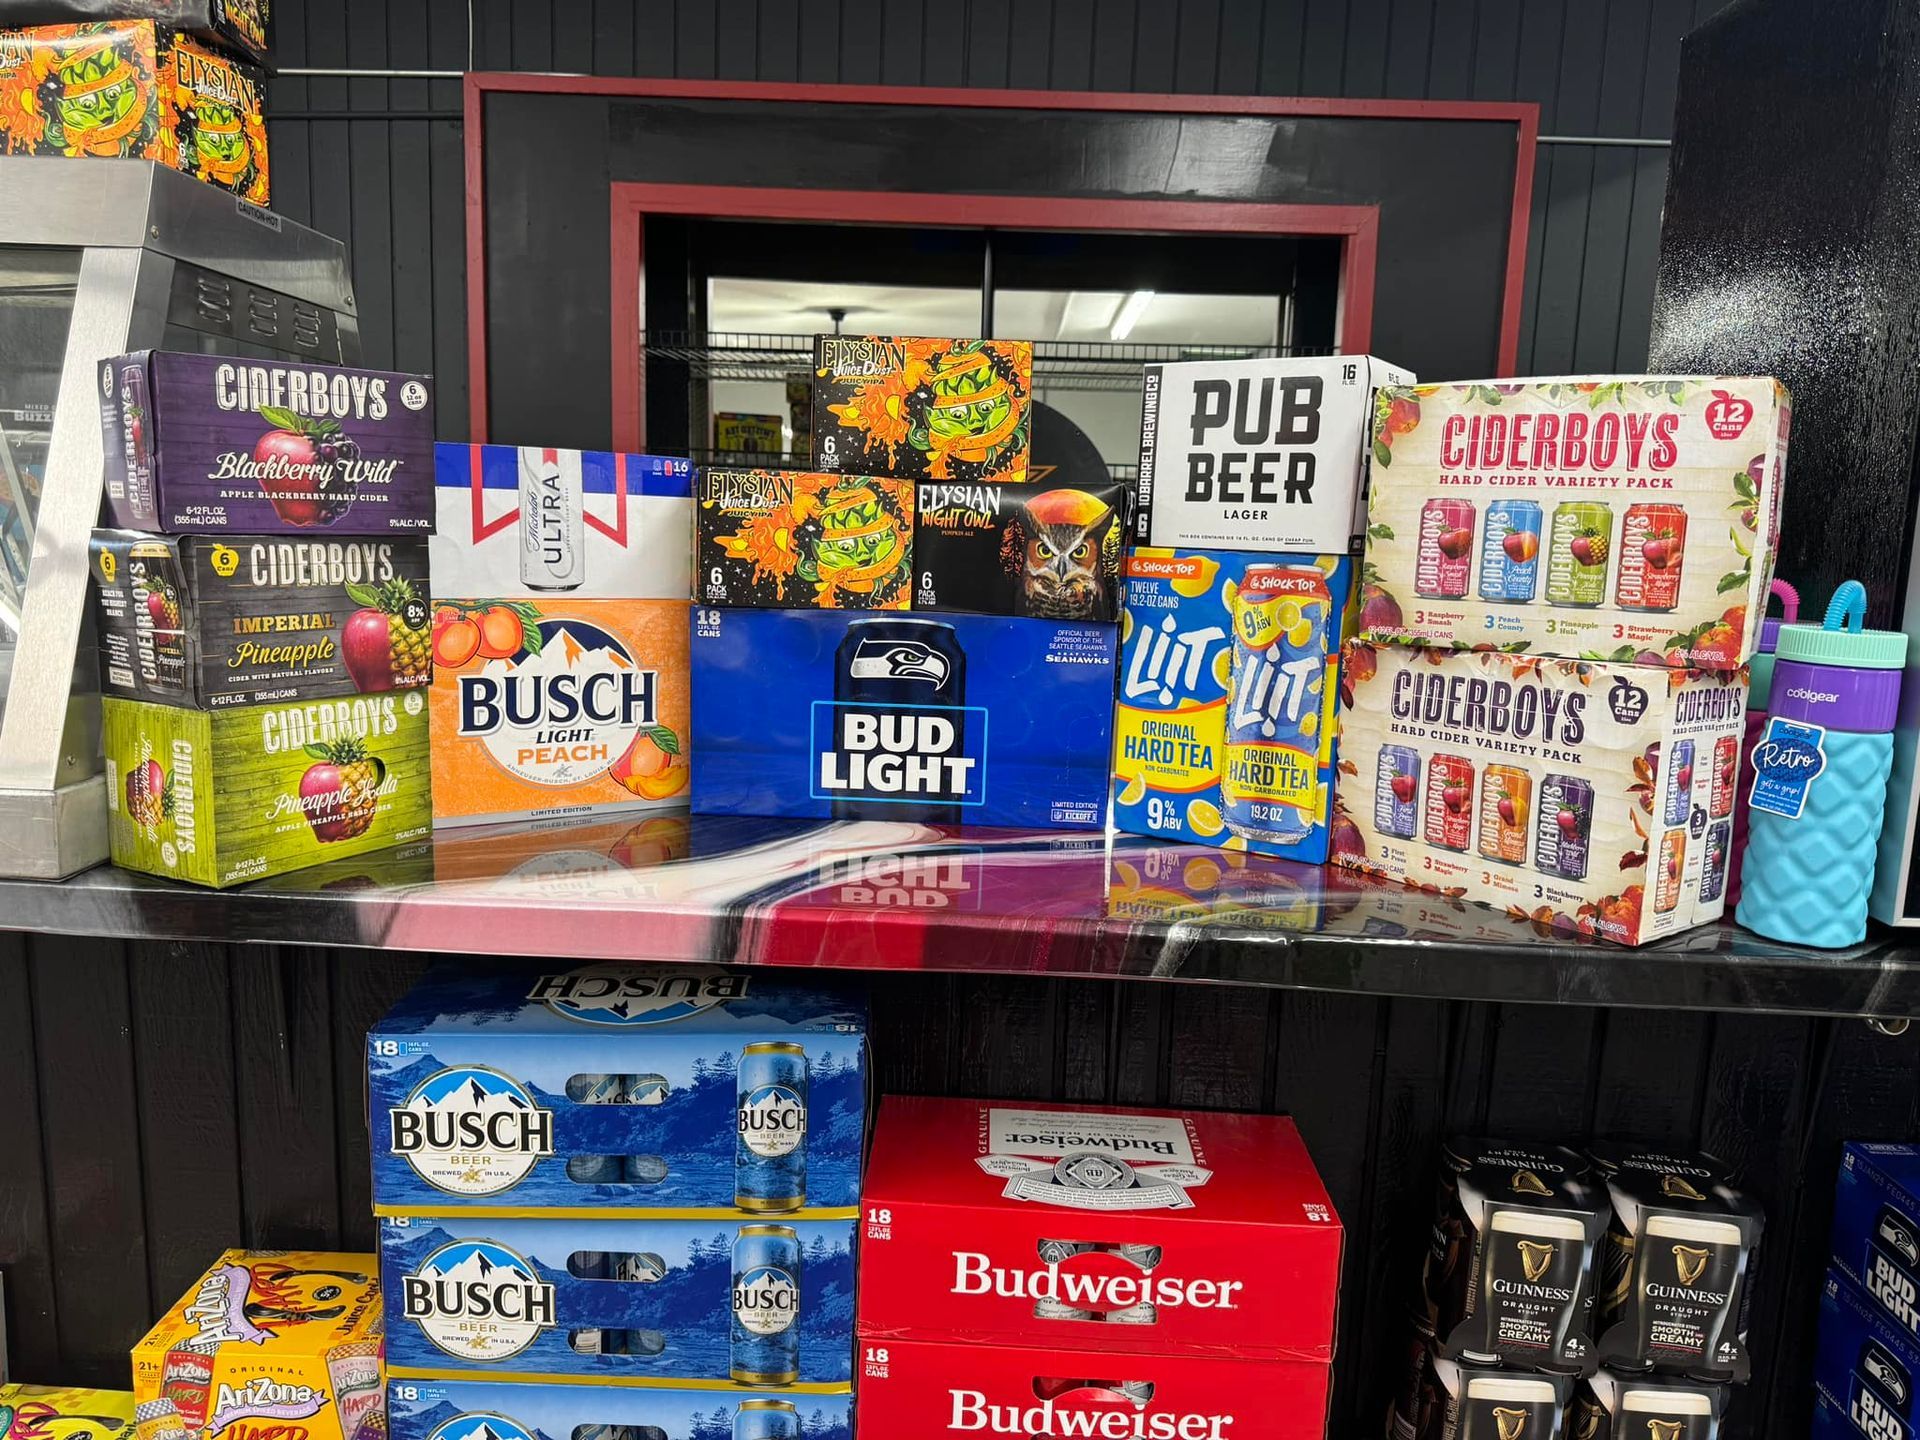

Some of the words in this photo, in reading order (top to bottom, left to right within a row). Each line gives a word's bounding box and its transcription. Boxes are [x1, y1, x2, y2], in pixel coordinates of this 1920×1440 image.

[179, 142, 186, 157] 6
[820, 338, 908, 372] ELYSIAN
[832, 358, 863, 377] JUICE
[862, 360, 894, 377] DUST
[1342, 364, 1357, 380] 16
[215, 363, 389, 420] CIDERBOYS
[409, 385, 417, 394] 6
[1190, 375, 1324, 446] PUB
[1713, 403, 1745, 423] 12
[1143, 391, 1157, 447] BREWING
[1712, 422, 1742, 431] Cans
[823, 436, 836, 455] 6
[1440, 412, 1680, 473] CIDERBOYS
[674, 461, 688, 472] 16
[819, 453, 840, 464] PACK
[208, 452, 333, 488] Blackberry
[336, 458, 397, 484] Wild
[1139, 446, 1153, 494] BARREL
[1184, 452, 1317, 504] BEER
[706, 471, 795, 506] ELYSIAN
[1439, 474, 1483, 486] HARD
[1489, 474, 1538, 487] CIDER
[1545, 475, 1621, 489] VARIETY
[1626, 477, 1674, 489] PACK
[220, 490, 254, 498] APPLE
[258, 491, 326, 500] BLACKBERRY
[329, 493, 356, 501] HARD
[360, 494, 389, 502] CIDER
[918, 483, 1002, 516] ELYSIAN
[527, 488, 541, 552] Michelob
[542, 474, 563, 564] ULTRA
[922, 508, 966, 530] NIGHT
[965, 506, 996, 530] OWL
[1137, 512, 1149, 532] 6
[1224, 509, 1268, 520] LAGER
[105, 557, 110, 570] 6
[219, 553, 230, 564] 6
[251, 543, 394, 586] CIDERBOYS
[711, 567, 723, 585] 6
[1142, 561, 1173, 574] SHOCK
[1174, 563, 1196, 575] TOP
[922, 571, 933, 590] 6
[1260, 575, 1294, 590] SHOCK
[1294, 577, 1316, 592] TOP
[1507, 573, 1532, 585] County
[706, 584, 727, 594] PACK
[918, 589, 936, 598] PACK
[1130, 581, 1159, 595] TWELVE
[408, 605, 424, 618] 8%
[697, 610, 721, 625] 18
[1414, 610, 1425, 624] 3
[1427, 611, 1464, 622] Raspberry
[233, 614, 335, 635] IMPERIAL
[1257, 614, 1272, 632] ABV
[1484, 614, 1495, 629] 3
[1498, 615, 1521, 623] Peach
[1497, 623, 1524, 633] County
[1545, 619, 1557, 634] 3
[1559, 620, 1599, 630] Pineapple
[1559, 627, 1578, 636] Hula
[1612, 623, 1624, 639] 3
[1628, 624, 1675, 636] Strawberry
[1627, 633, 1653, 642] Magic
[228, 636, 335, 668] Pineapple
[1075, 643, 1107, 651] SEAHAWKS
[1045, 654, 1110, 664] SEAHAWKS
[459, 671, 656, 734] BUSCH
[1614, 687, 1642, 708] 12
[1787, 687, 1839, 704] coolgear
[1390, 669, 1587, 747] CIDERBOYS
[1614, 706, 1641, 717] Cans
[1675, 687, 1742, 725] CIDERBOYS
[262, 696, 399, 755] CIDERBOYS
[843, 713, 956, 754] BUD
[1142, 720, 1197, 742] ORIGINAL
[535, 728, 594, 744] LIGHT
[1391, 724, 1426, 739] HARD
[1430, 730, 1471, 746] CIDER
[1475, 736, 1539, 757] VARIETY
[1542, 747, 1583, 764] PACK
[517, 744, 608, 766] PEACH
[1124, 735, 1175, 764] HARD
[1178, 740, 1214, 771] TEA
[1243, 748, 1297, 768] ORIGINAL
[1761, 743, 1815, 769] Retro
[1229, 759, 1276, 786] HARD
[1279, 765, 1310, 791] TEA
[1065, 812, 1092, 820] KICKOFF
[1162, 817, 1182, 831] ABV
[1694, 812, 1702, 826] 3
[1423, 856, 1432, 870] 3
[1435, 858, 1469, 873] Strawberry
[1434, 865, 1453, 876] Magic
[1481, 871, 1491, 885] 3
[1493, 873, 1514, 884] Grand
[1533, 884, 1543, 898] 3
[1546, 887, 1584, 903] Blackberry
[1546, 894, 1562, 904] Wild
[527, 974, 752, 1000] BUSCH
[375, 1040, 399, 1056] 18
[738, 1108, 807, 1133] BUSCH
[391, 1108, 553, 1153] BUSCH
[978, 1107, 989, 1154] GENUINE
[1004, 1132, 1178, 1156] Budweiser
[1184, 1118, 1207, 1166] GENUINE
[450, 1155, 492, 1165] BEER
[1843, 1152, 1855, 1165] 18
[868, 1209, 892, 1225] 18
[867, 1231, 891, 1240] CANS
[950, 1251, 1244, 1309] Budweiser
[1875, 1255, 1916, 1305] BUD
[1492, 1279, 1571, 1301] GUINNESS
[1645, 1282, 1725, 1305] GUINNESS
[402, 1276, 556, 1326] BUSCH
[732, 1288, 800, 1313] BUSCH
[1502, 1300, 1556, 1313] DRAUGHT
[1655, 1304, 1709, 1317] DRAUGHT
[459, 1322, 498, 1332] BEER
[1500, 1321, 1541, 1333] SMOOTH
[1652, 1325, 1694, 1337] SMOOTH
[1498, 1329, 1551, 1343] CREAMY
[1650, 1332, 1704, 1347] CREAMY
[865, 1348, 889, 1364] 18
[1719, 1342, 1738, 1354] 4x
[138, 1362, 160, 1371] 21+
[230, 1367, 305, 1376] ORIGINAL
[865, 1370, 889, 1379] CANS
[216, 1377, 317, 1416] AriZona
[396, 1386, 419, 1401] 18
